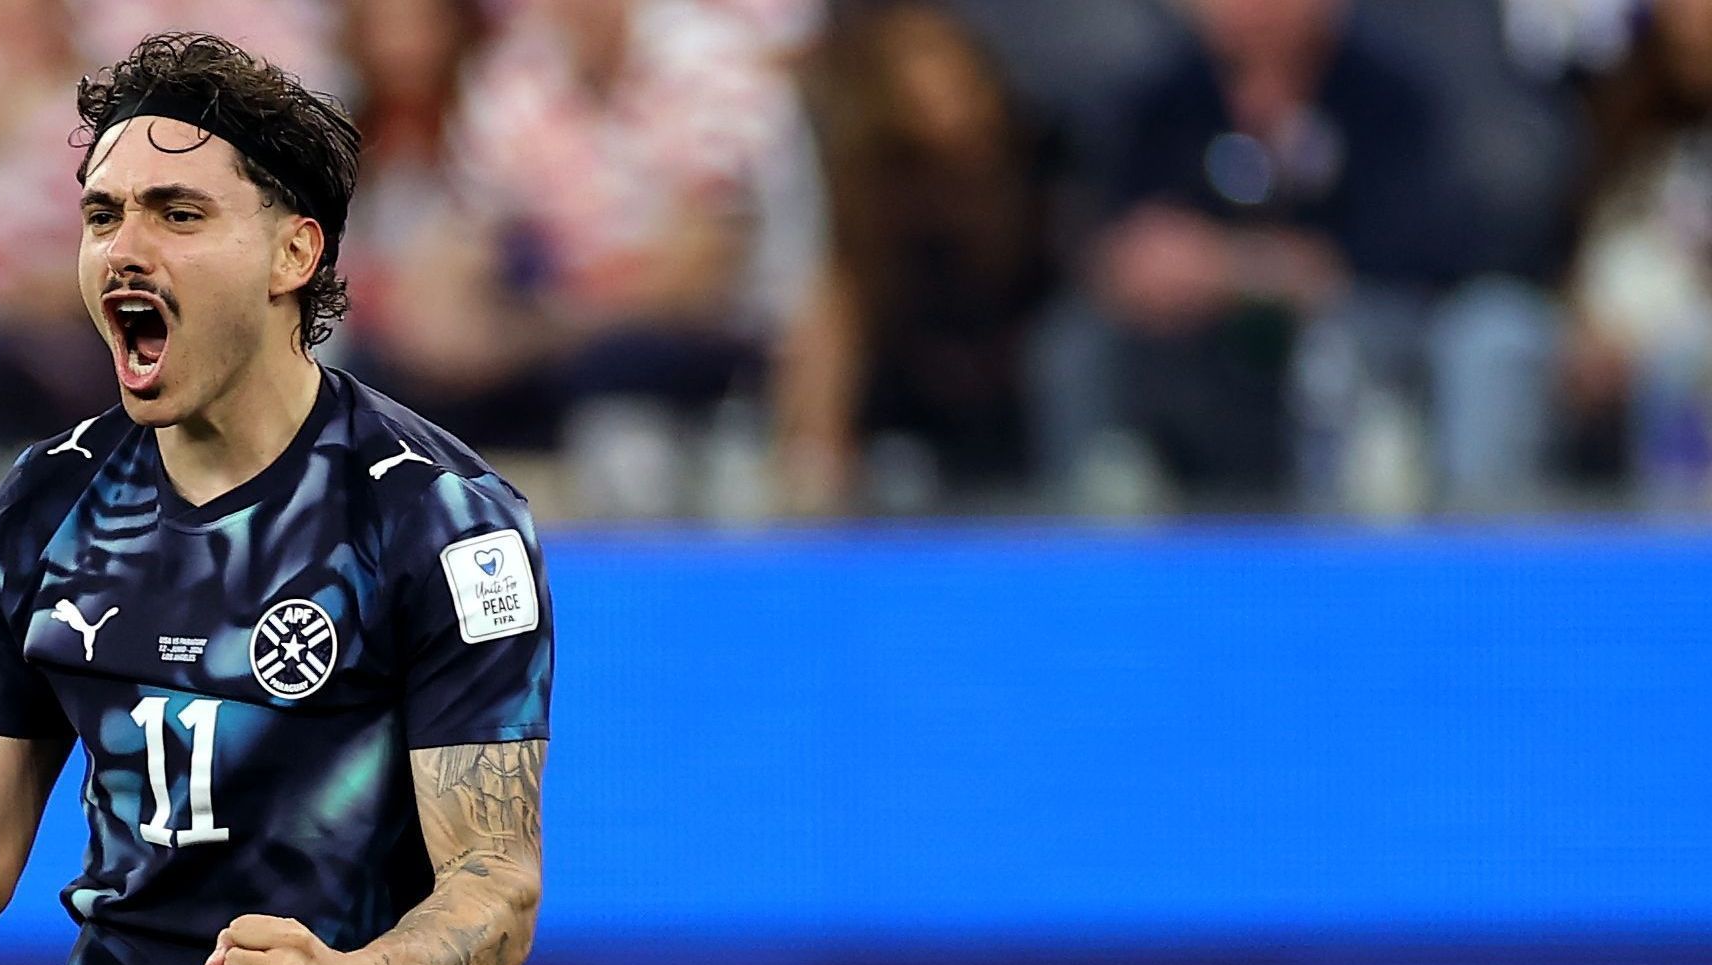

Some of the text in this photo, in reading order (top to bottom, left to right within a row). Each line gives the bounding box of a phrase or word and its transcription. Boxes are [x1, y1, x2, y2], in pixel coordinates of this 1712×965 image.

[475, 575, 518, 599] Unite For
[482, 593, 520, 616] PEACE
[281, 607, 313, 625] APF
[493, 615, 516, 626] FIFA
[268, 677, 309, 693] PARAGUAY
[130, 696, 230, 848] 11
